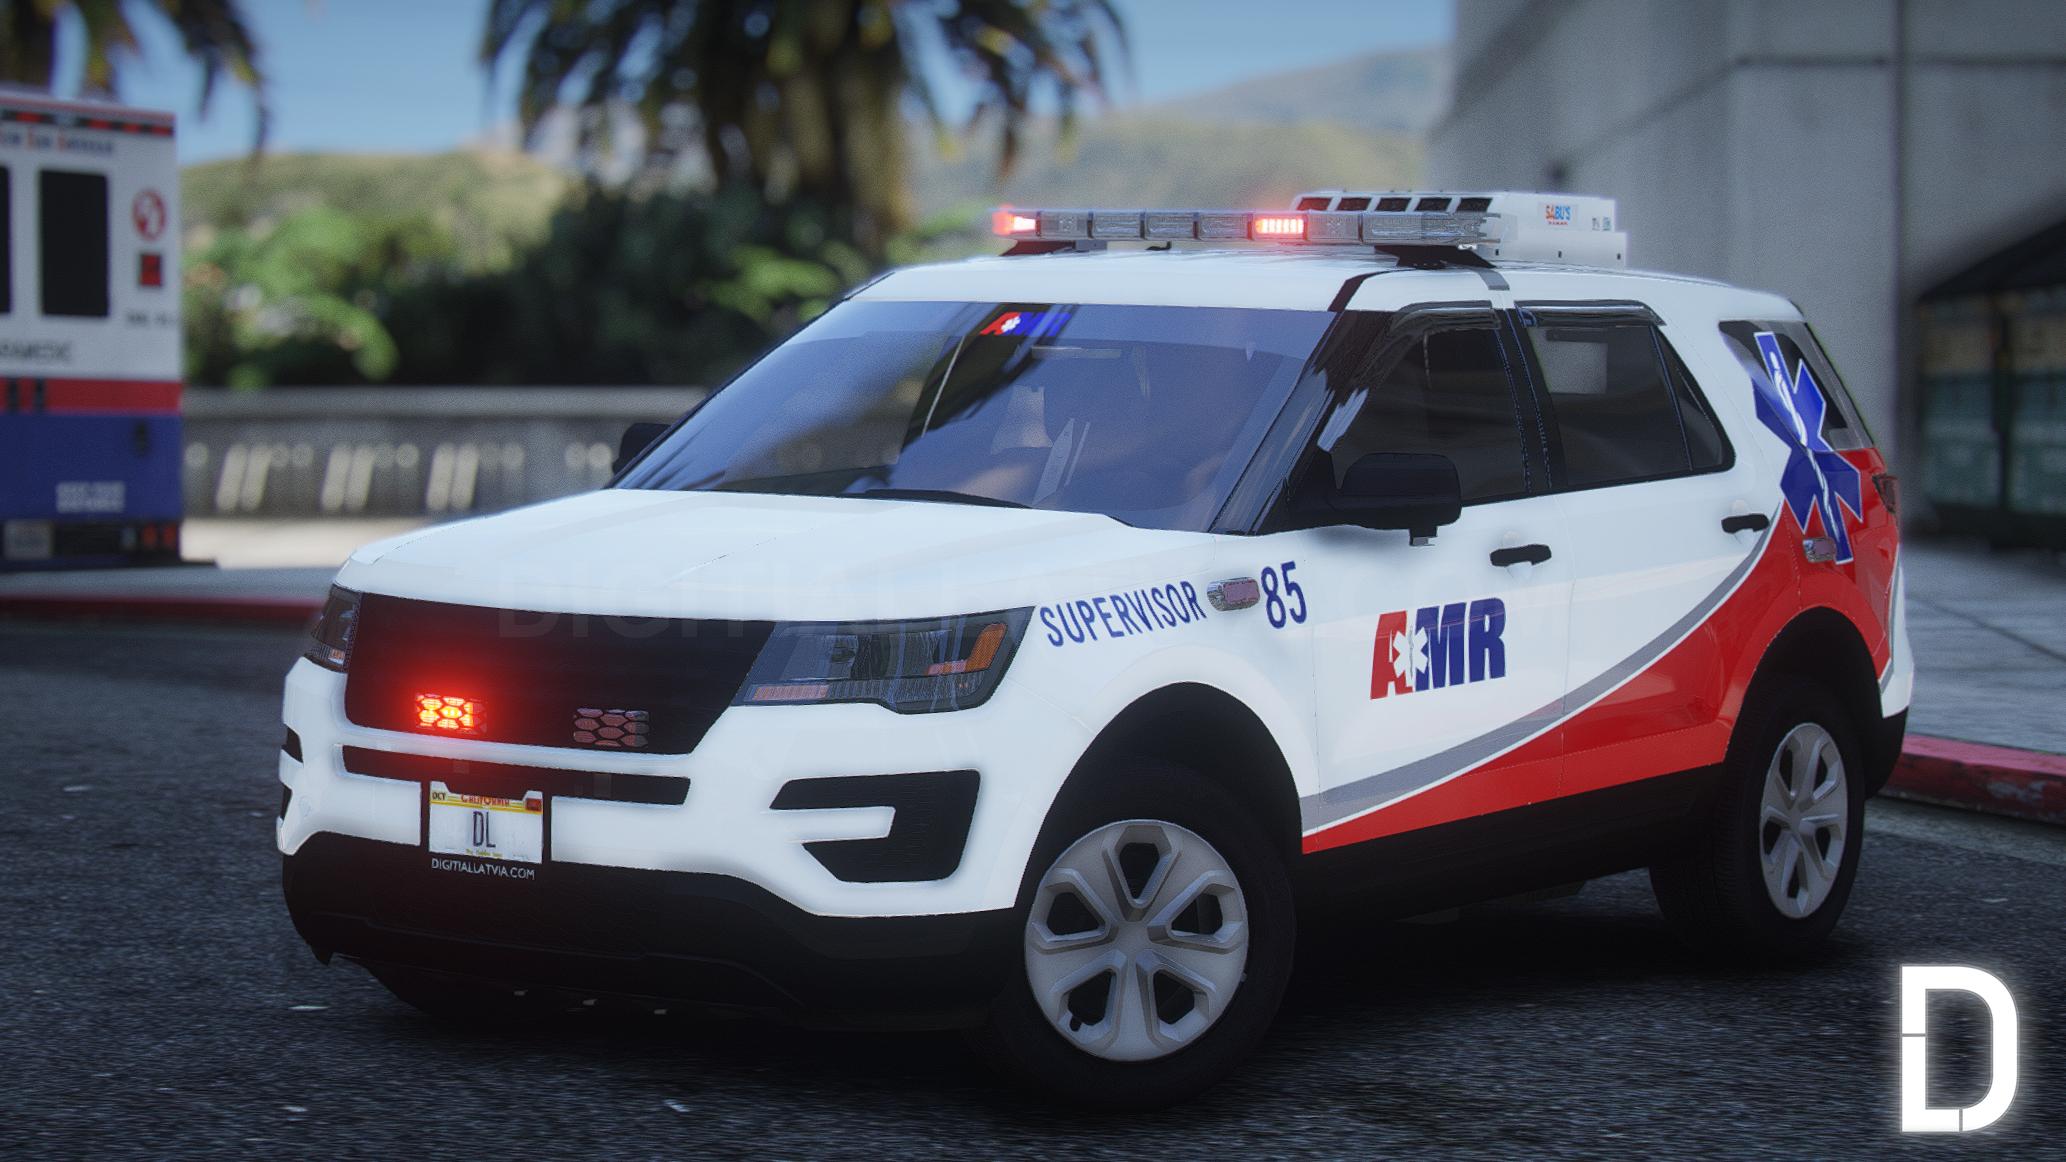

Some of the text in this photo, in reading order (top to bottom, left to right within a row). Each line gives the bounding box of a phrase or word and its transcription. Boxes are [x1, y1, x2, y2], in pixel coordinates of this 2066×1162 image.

[1040, 561, 1307, 648] SUPERVISOR 85
[1370, 597, 1507, 700] AMR
[473, 811, 496, 848] DL
